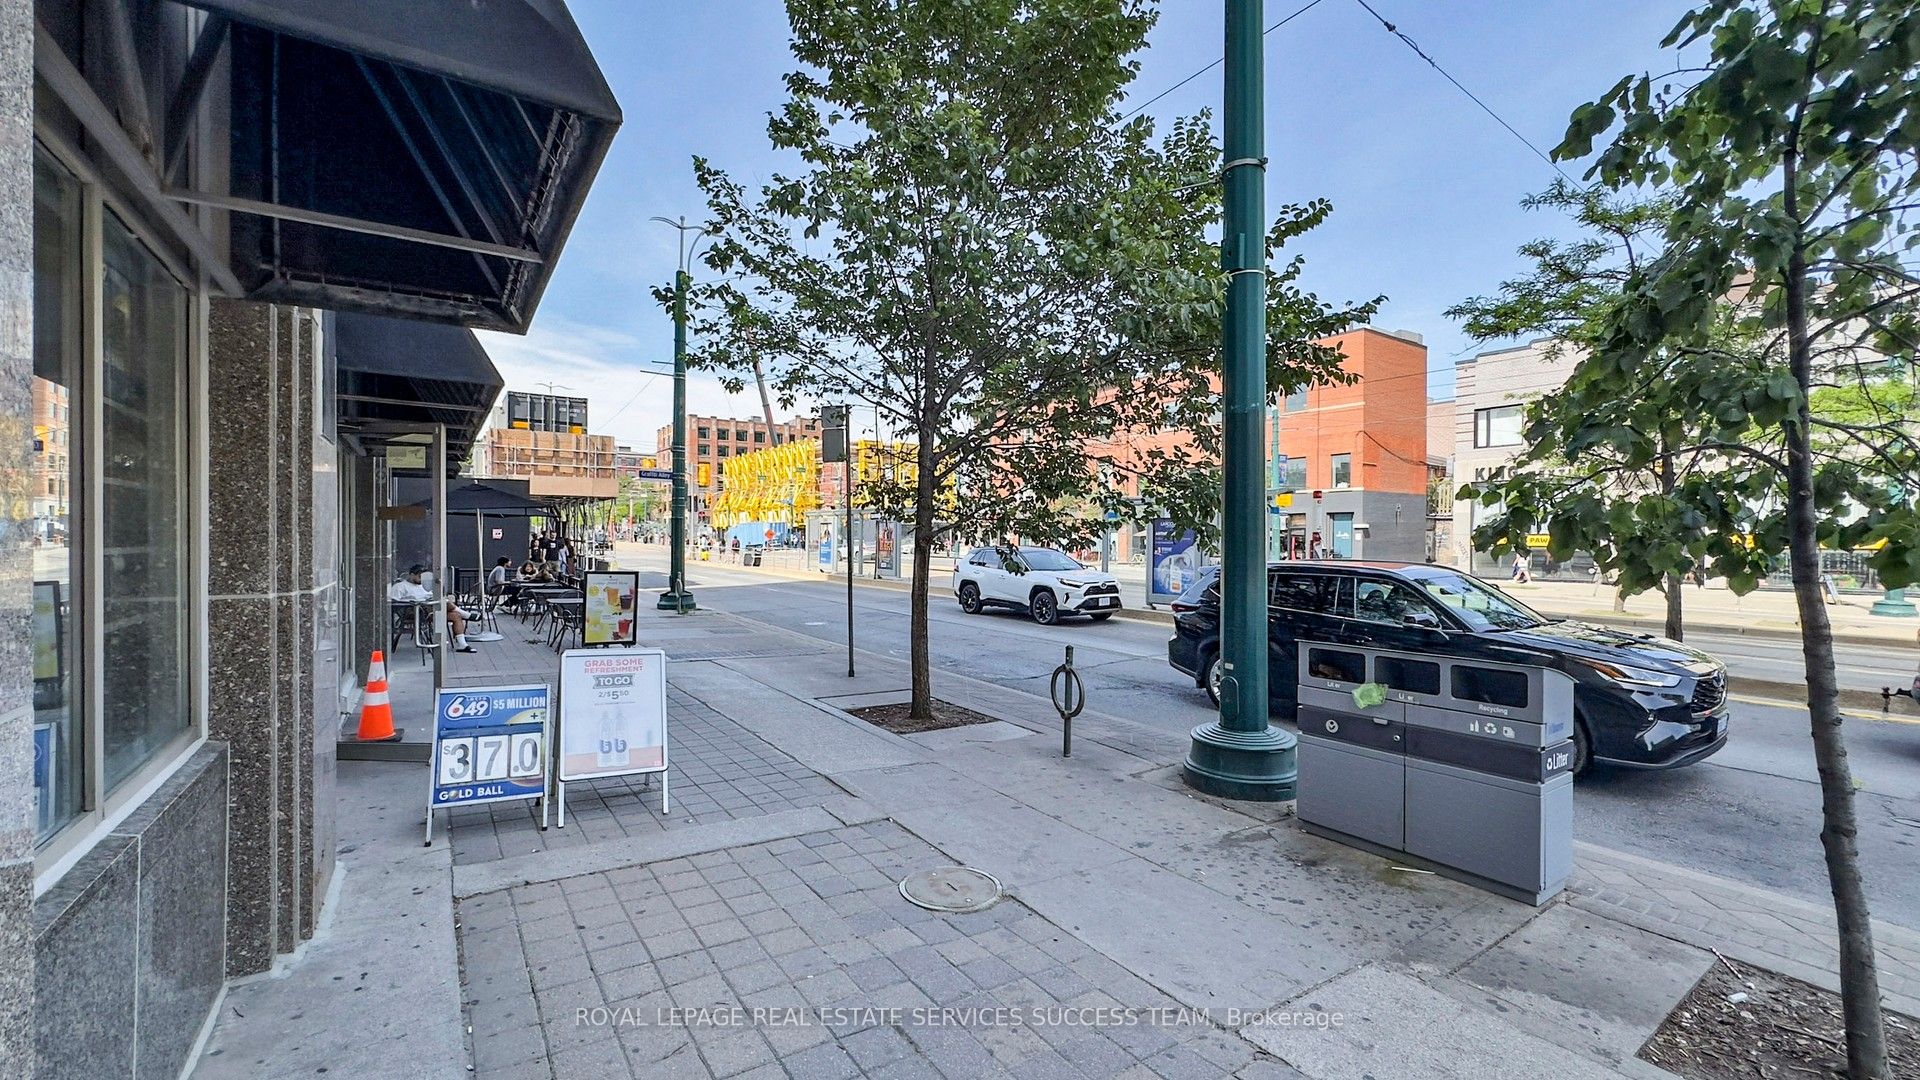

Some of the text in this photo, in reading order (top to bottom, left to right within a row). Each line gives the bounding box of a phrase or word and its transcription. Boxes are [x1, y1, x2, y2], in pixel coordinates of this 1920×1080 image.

[616, 658, 643, 666] SOME
[584, 666, 643, 674] REFRESHMENT
[599, 676, 631, 686] TO GO
[493, 697, 546, 710] $5 MILLION
[1478, 703, 1509, 716] Recycling
[1552, 752, 1569, 770] Litter
[477, 785, 504, 796] BALL
